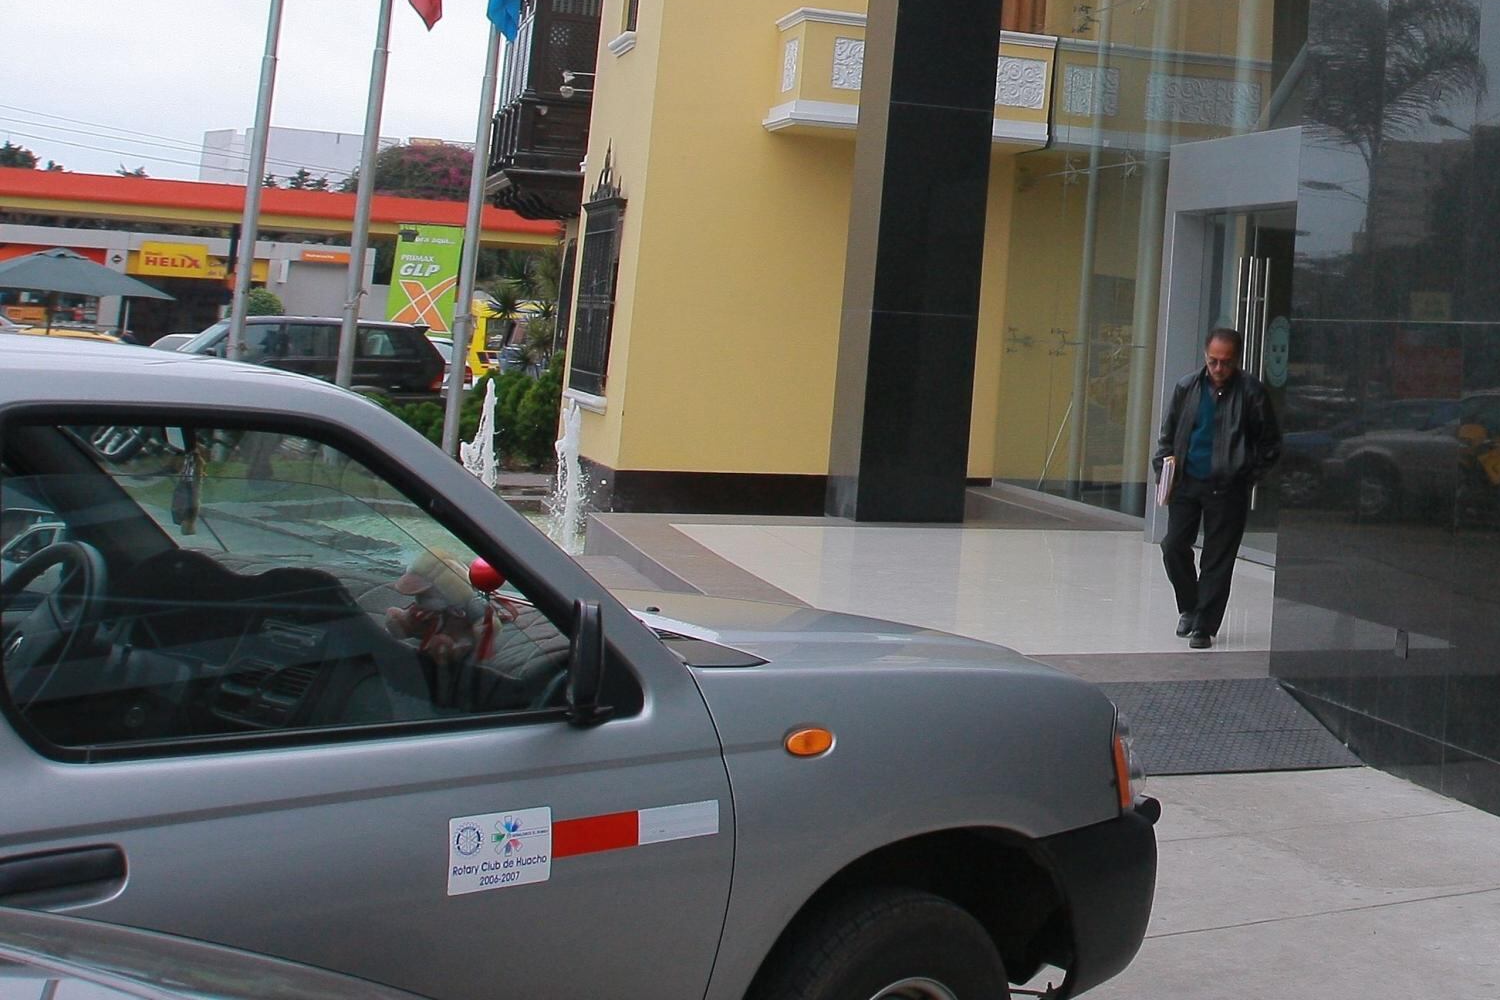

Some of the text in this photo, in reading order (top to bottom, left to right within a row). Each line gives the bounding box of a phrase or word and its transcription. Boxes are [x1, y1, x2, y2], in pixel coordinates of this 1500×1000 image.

[145, 255, 200, 269] HELIX
[400, 262, 440, 277] GLP
[452, 855, 547, 876] Rotary Club de Huacho
[480, 871, 520, 886] 2006-2007
